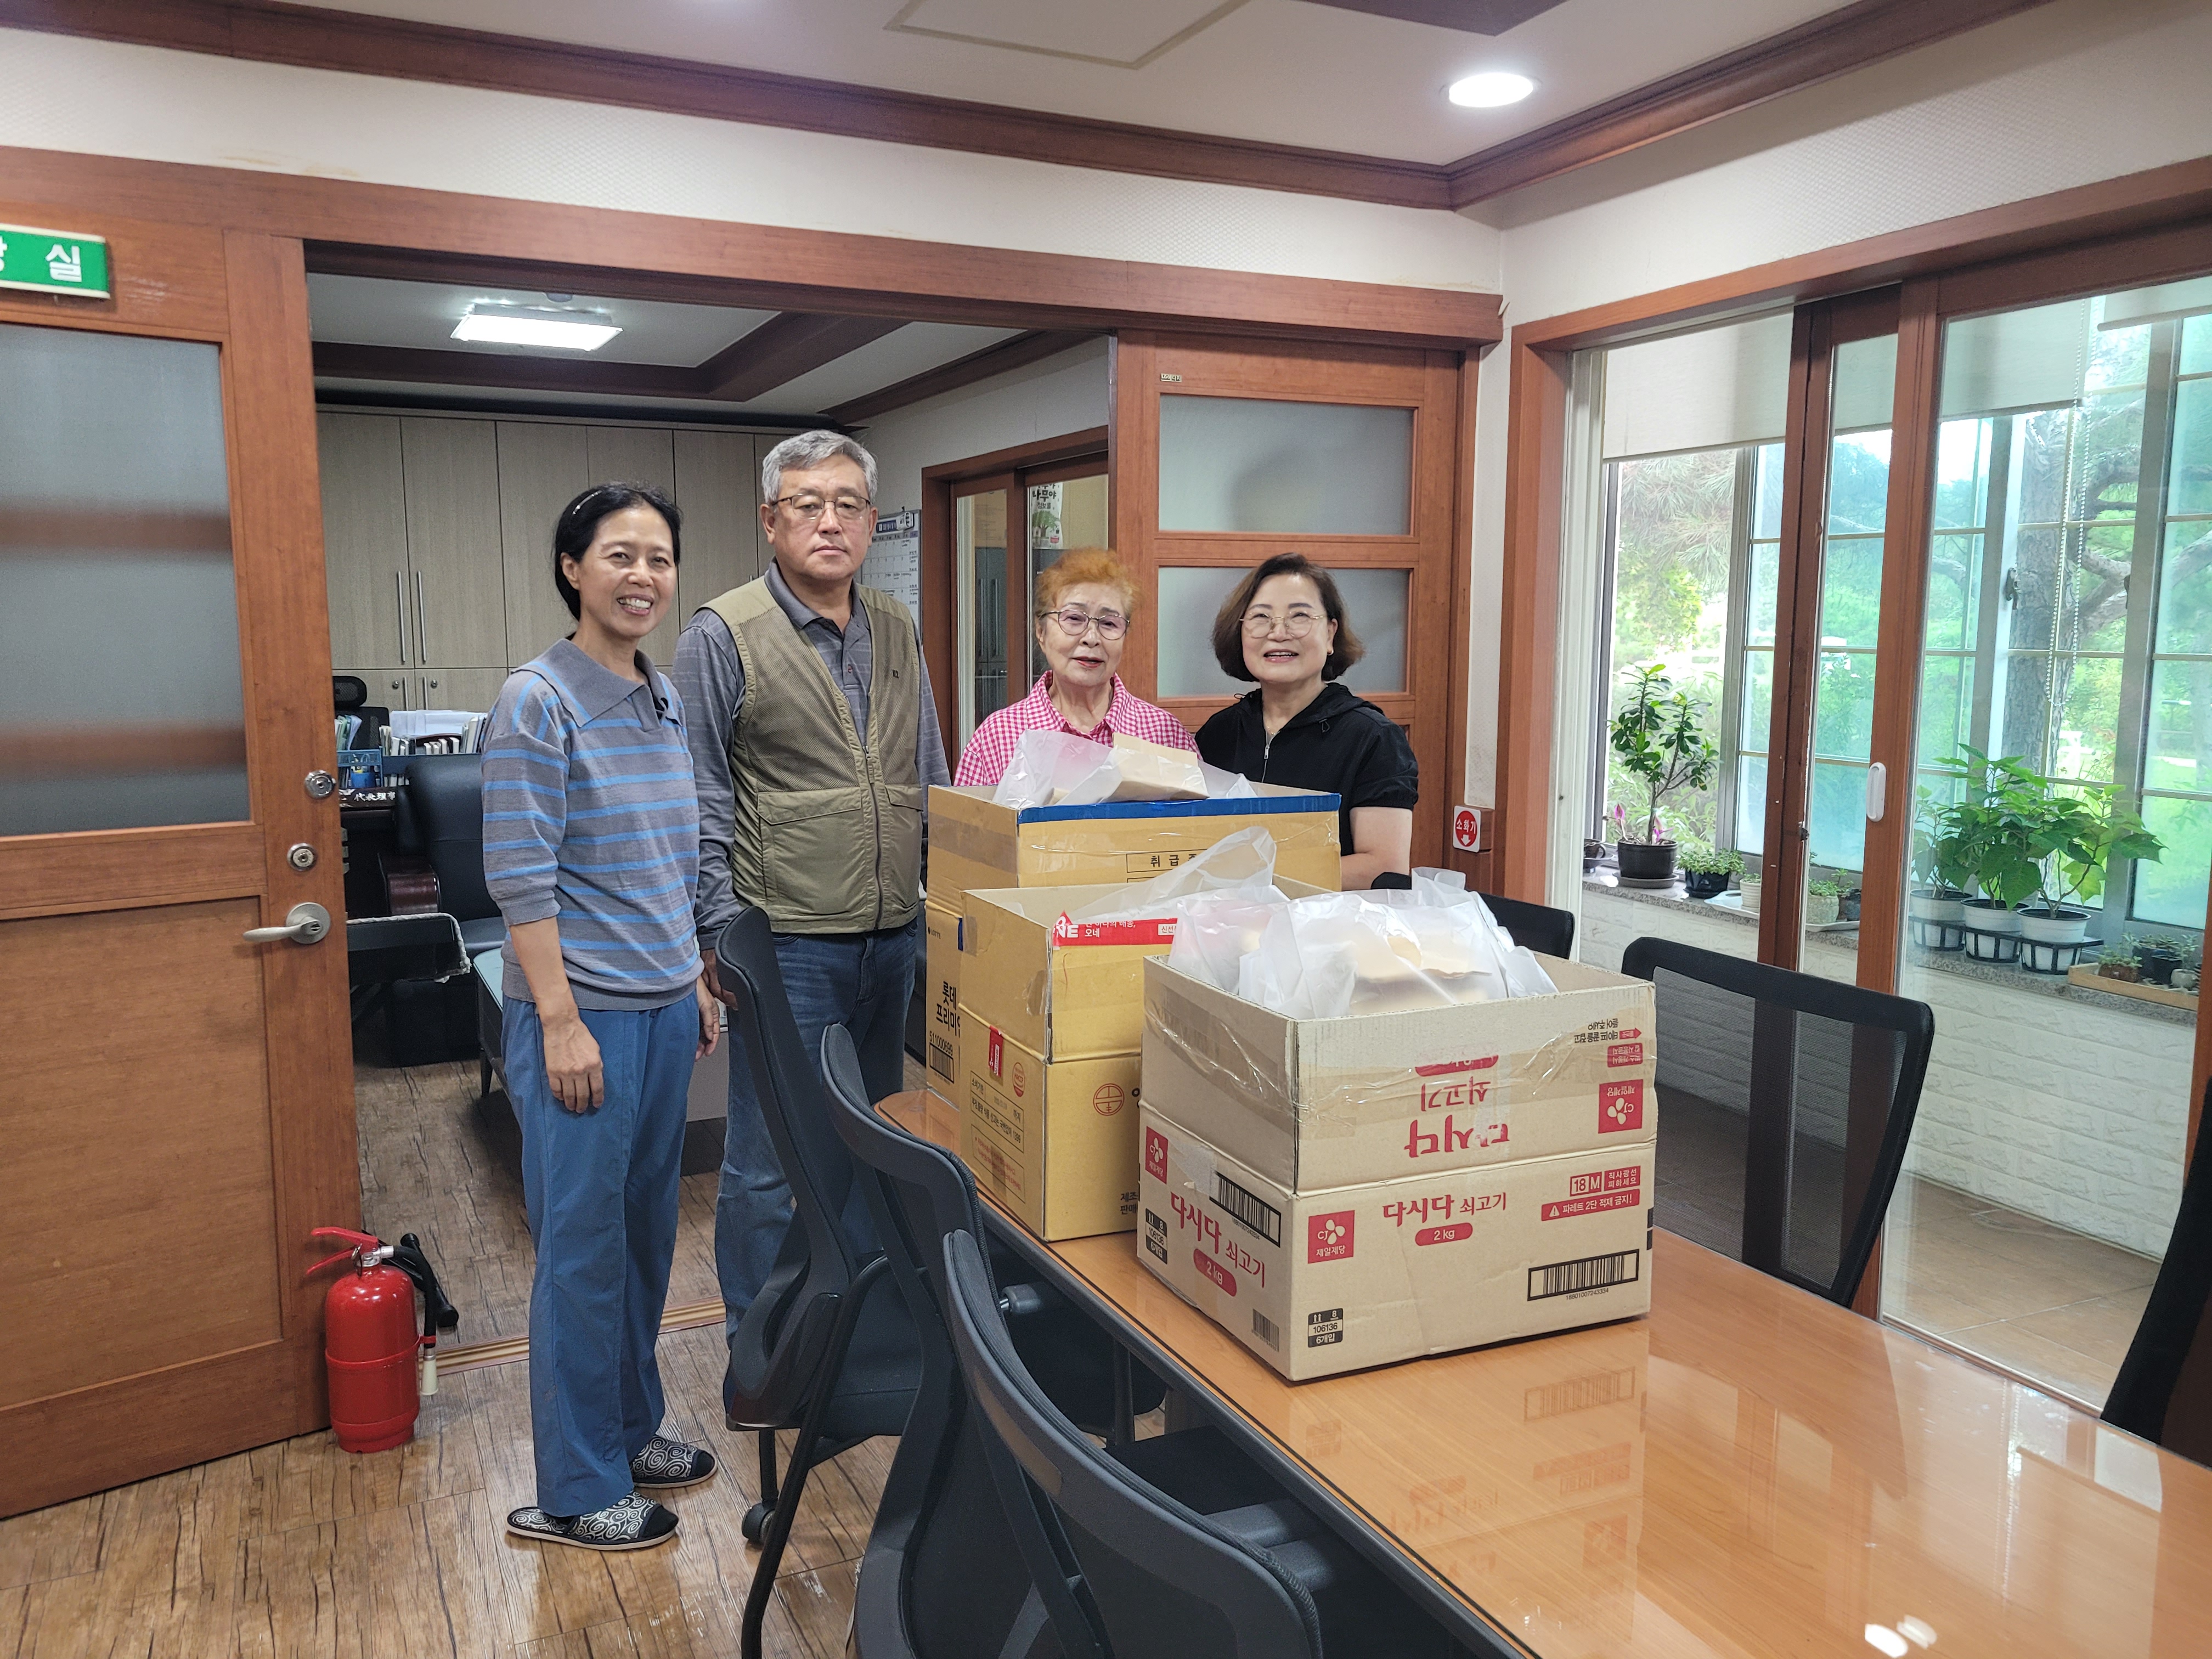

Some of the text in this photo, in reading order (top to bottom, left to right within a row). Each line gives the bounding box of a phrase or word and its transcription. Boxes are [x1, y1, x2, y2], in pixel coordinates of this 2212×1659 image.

[1032, 489, 1057, 502] 나무야
[1457, 819, 1476, 834] 소화기
[1085, 928, 1100, 938] 오네
[943, 981, 957, 1011] 롯데
[1574, 1030, 1618, 1043] 테이프 끝을 잡고
[1421, 1076, 1491, 1112] 쇠고기
[1607, 1086, 1635, 1097] 제일제당
[1623, 1103, 1634, 1113] CJ
[1404, 1115, 1510, 1158] 다시다
[1609, 1168, 1637, 1179] 직사광선
[1574, 1176, 1600, 1192] 18 M
[1608, 1177, 1637, 1188] 피하세요
[1383, 1192, 1506, 1227] 다시다 쇠고기
[1562, 1194, 1632, 1214] 파레트 2단 적재 금지!
[1170, 1192, 1265, 1288] 다시다 쇠고기
[1317, 1230, 1329, 1240] CJ
[1443, 1229, 1455, 1239] kg
[1316, 1245, 1346, 1257] 제일제당
[1313, 1322, 1338, 1334] 106136
[1316, 1333, 1335, 1344] 6개입
